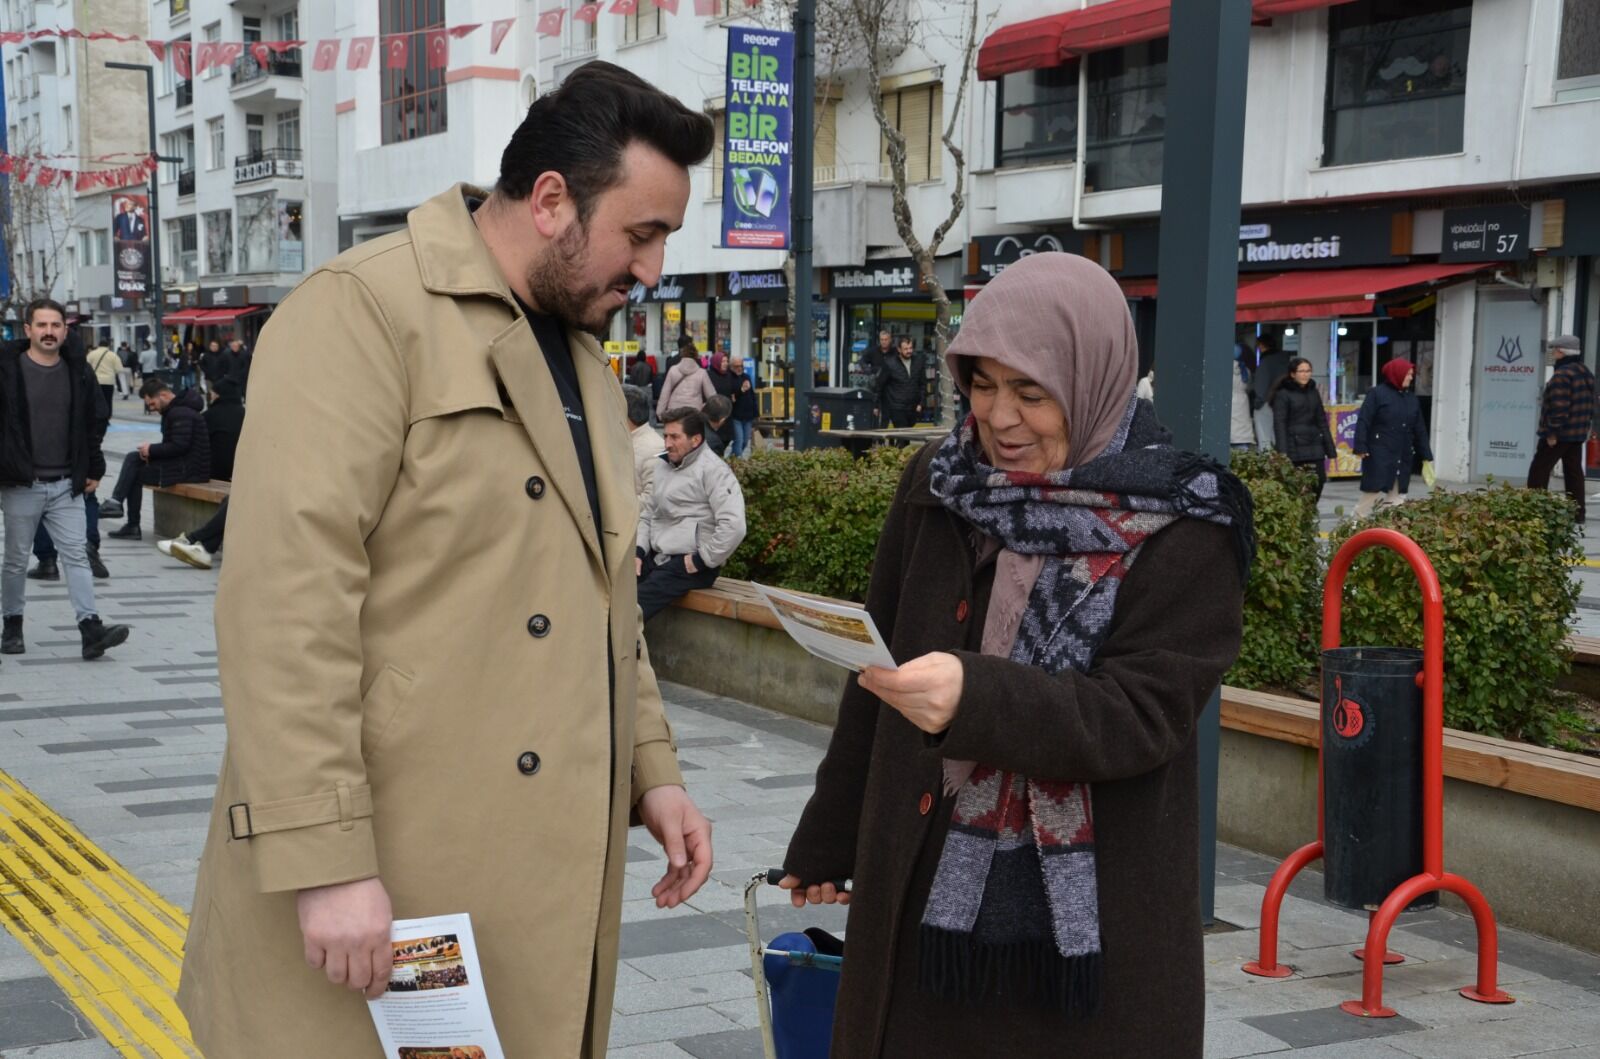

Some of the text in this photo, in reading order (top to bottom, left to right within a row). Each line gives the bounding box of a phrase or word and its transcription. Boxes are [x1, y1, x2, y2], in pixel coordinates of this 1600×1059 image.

[731, 46, 778, 81] BİR
[731, 79, 789, 95] TELEFON
[730, 91, 789, 108] ALANA
[729, 105, 778, 140] BİR
[729, 139, 789, 154] TELEFON
[728, 151, 781, 166] BEDAVA
[1488, 223, 1500, 231] no
[1247, 235, 1340, 262] kahvecisi
[1496, 234, 1518, 253] 57
[741, 272, 785, 288] TURKCELL
